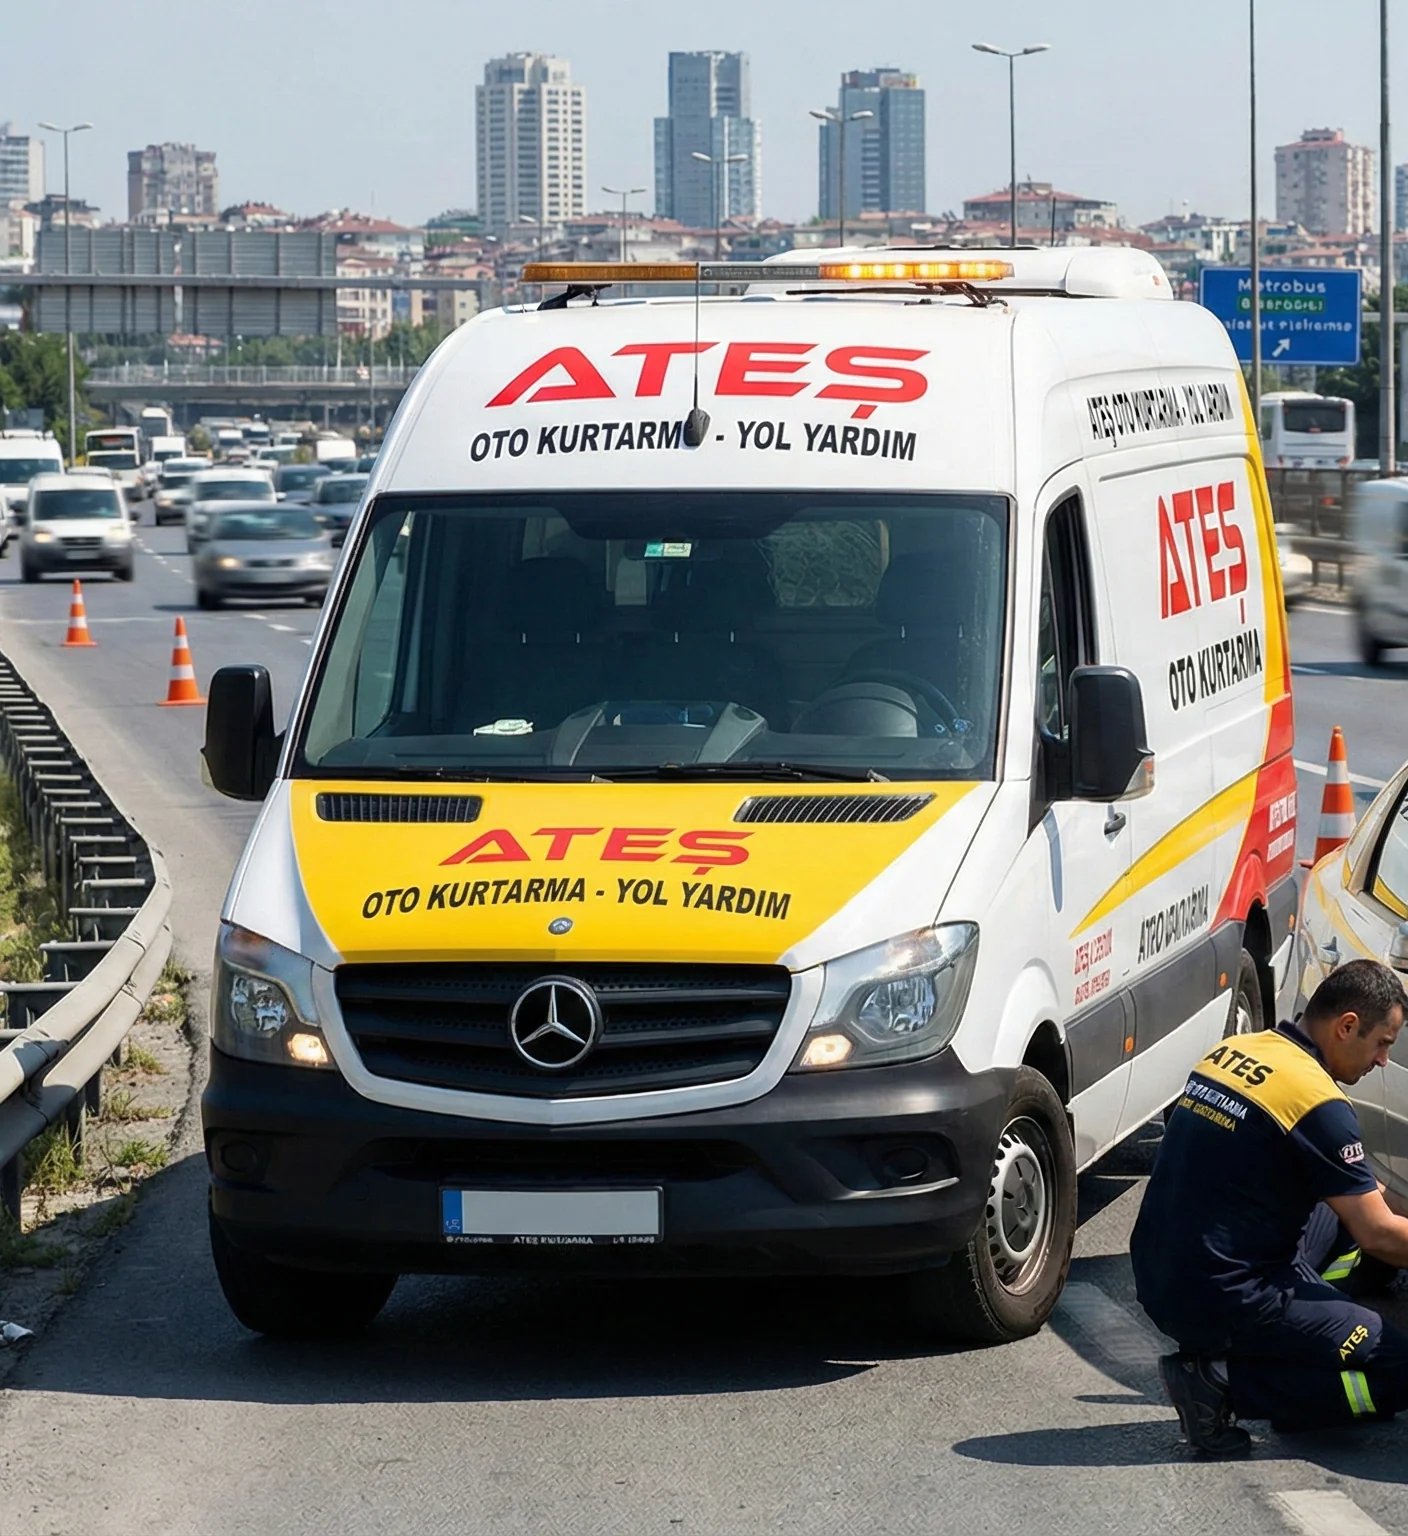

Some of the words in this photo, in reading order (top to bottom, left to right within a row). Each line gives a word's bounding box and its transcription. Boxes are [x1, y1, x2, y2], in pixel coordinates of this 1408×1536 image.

[485, 341, 932, 419] ATEŞ
[470, 427, 529, 463] OTO
[537, 420, 692, 454] KURTARM
[738, 421, 791, 451] YOL
[803, 423, 918, 462] YARDIM
[1157, 480, 1248, 625] ATEŞ
[1168, 656, 1196, 712] OTO
[1198, 628, 1263, 699] KURTARMA
[438, 827, 756, 876] ATEŞ
[362, 888, 420, 920] OTO
[427, 879, 586, 910] KURTARMA
[616, 880, 668, 905] YOL
[679, 882, 791, 921] YARDIM
